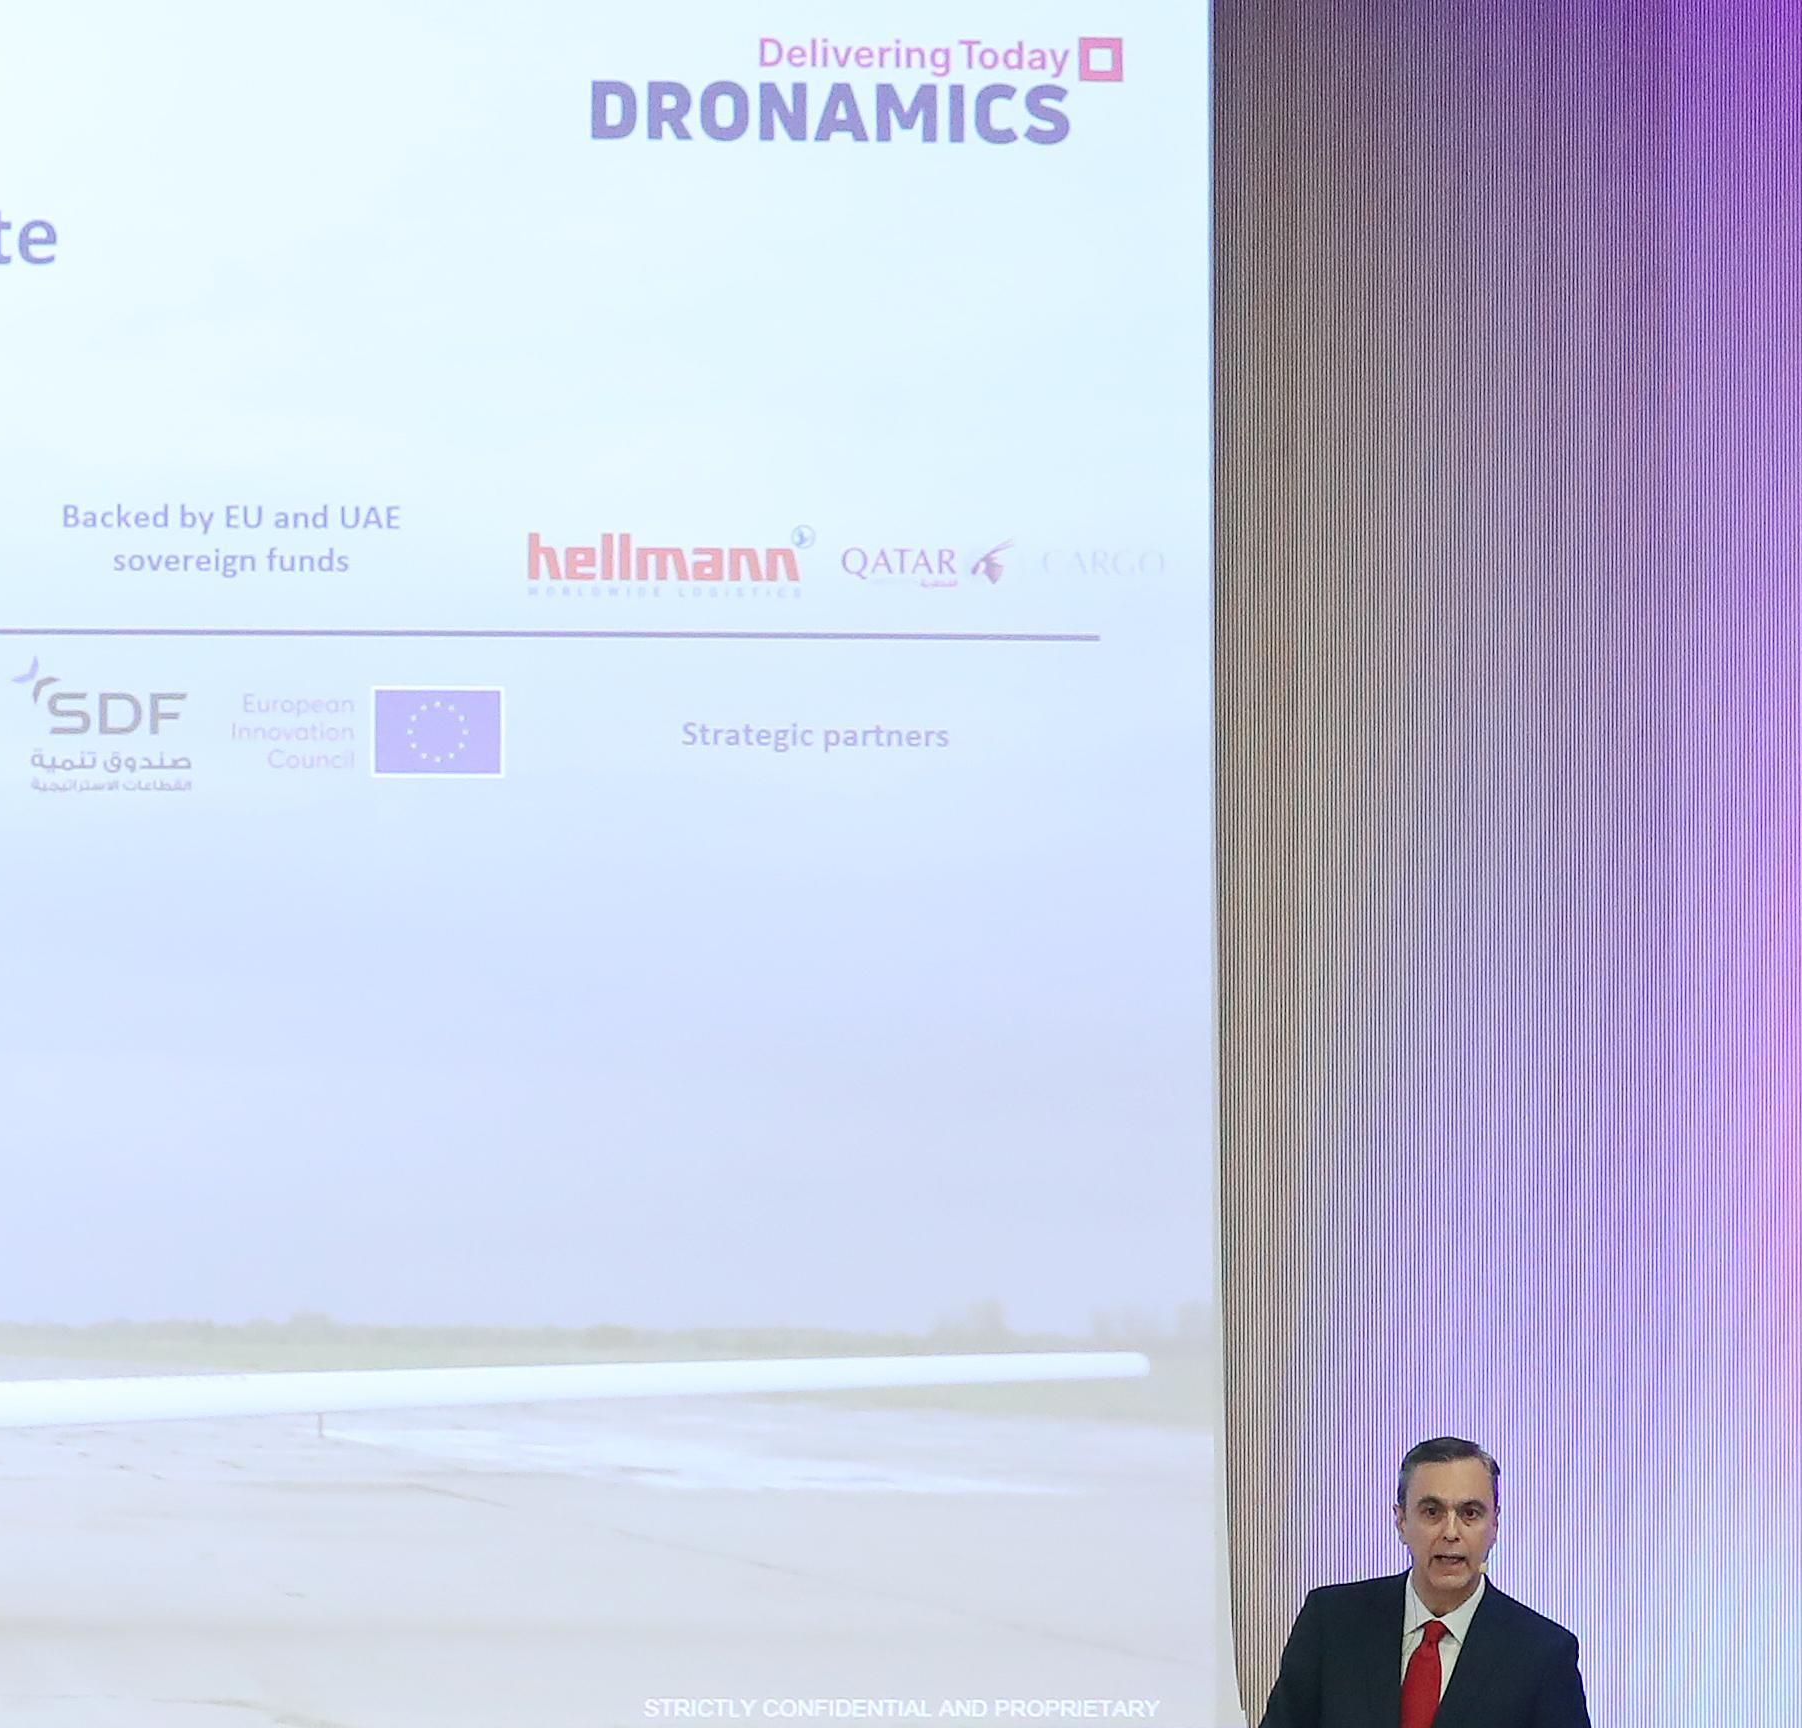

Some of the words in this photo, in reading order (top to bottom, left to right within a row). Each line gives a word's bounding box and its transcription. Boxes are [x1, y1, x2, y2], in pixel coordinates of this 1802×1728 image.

[759, 38, 952, 77] Delivering
[959, 39, 1069, 78] Today
[590, 79, 1071, 145] DRONAMICS
[62, 504, 169, 530] Backed
[181, 504, 214, 534] by
[225, 506, 264, 530] EU
[274, 505, 329, 530] and
[340, 507, 401, 530] UAE
[113, 549, 256, 578] sovereign
[266, 548, 350, 574] funds
[528, 532, 800, 582] hellmann
[840, 548, 956, 578] QATAR
[1040, 550, 1166, 576] CARGO
[48, 691, 188, 735] SDF
[242, 694, 355, 718] European
[231, 722, 355, 743] Innovation
[682, 722, 814, 752] Strategic
[823, 725, 950, 751] partners
[31, 751, 97, 772] تنمية
[103, 750, 192, 772] صندوق
[267, 748, 355, 771] Council
[643, 1699, 756, 1718] STRICTLY
[763, 1698, 933, 1718] CONFIDENTIAL
[938, 1699, 988, 1718] AND
[999, 1699, 1160, 1718] PROPRIETARY
